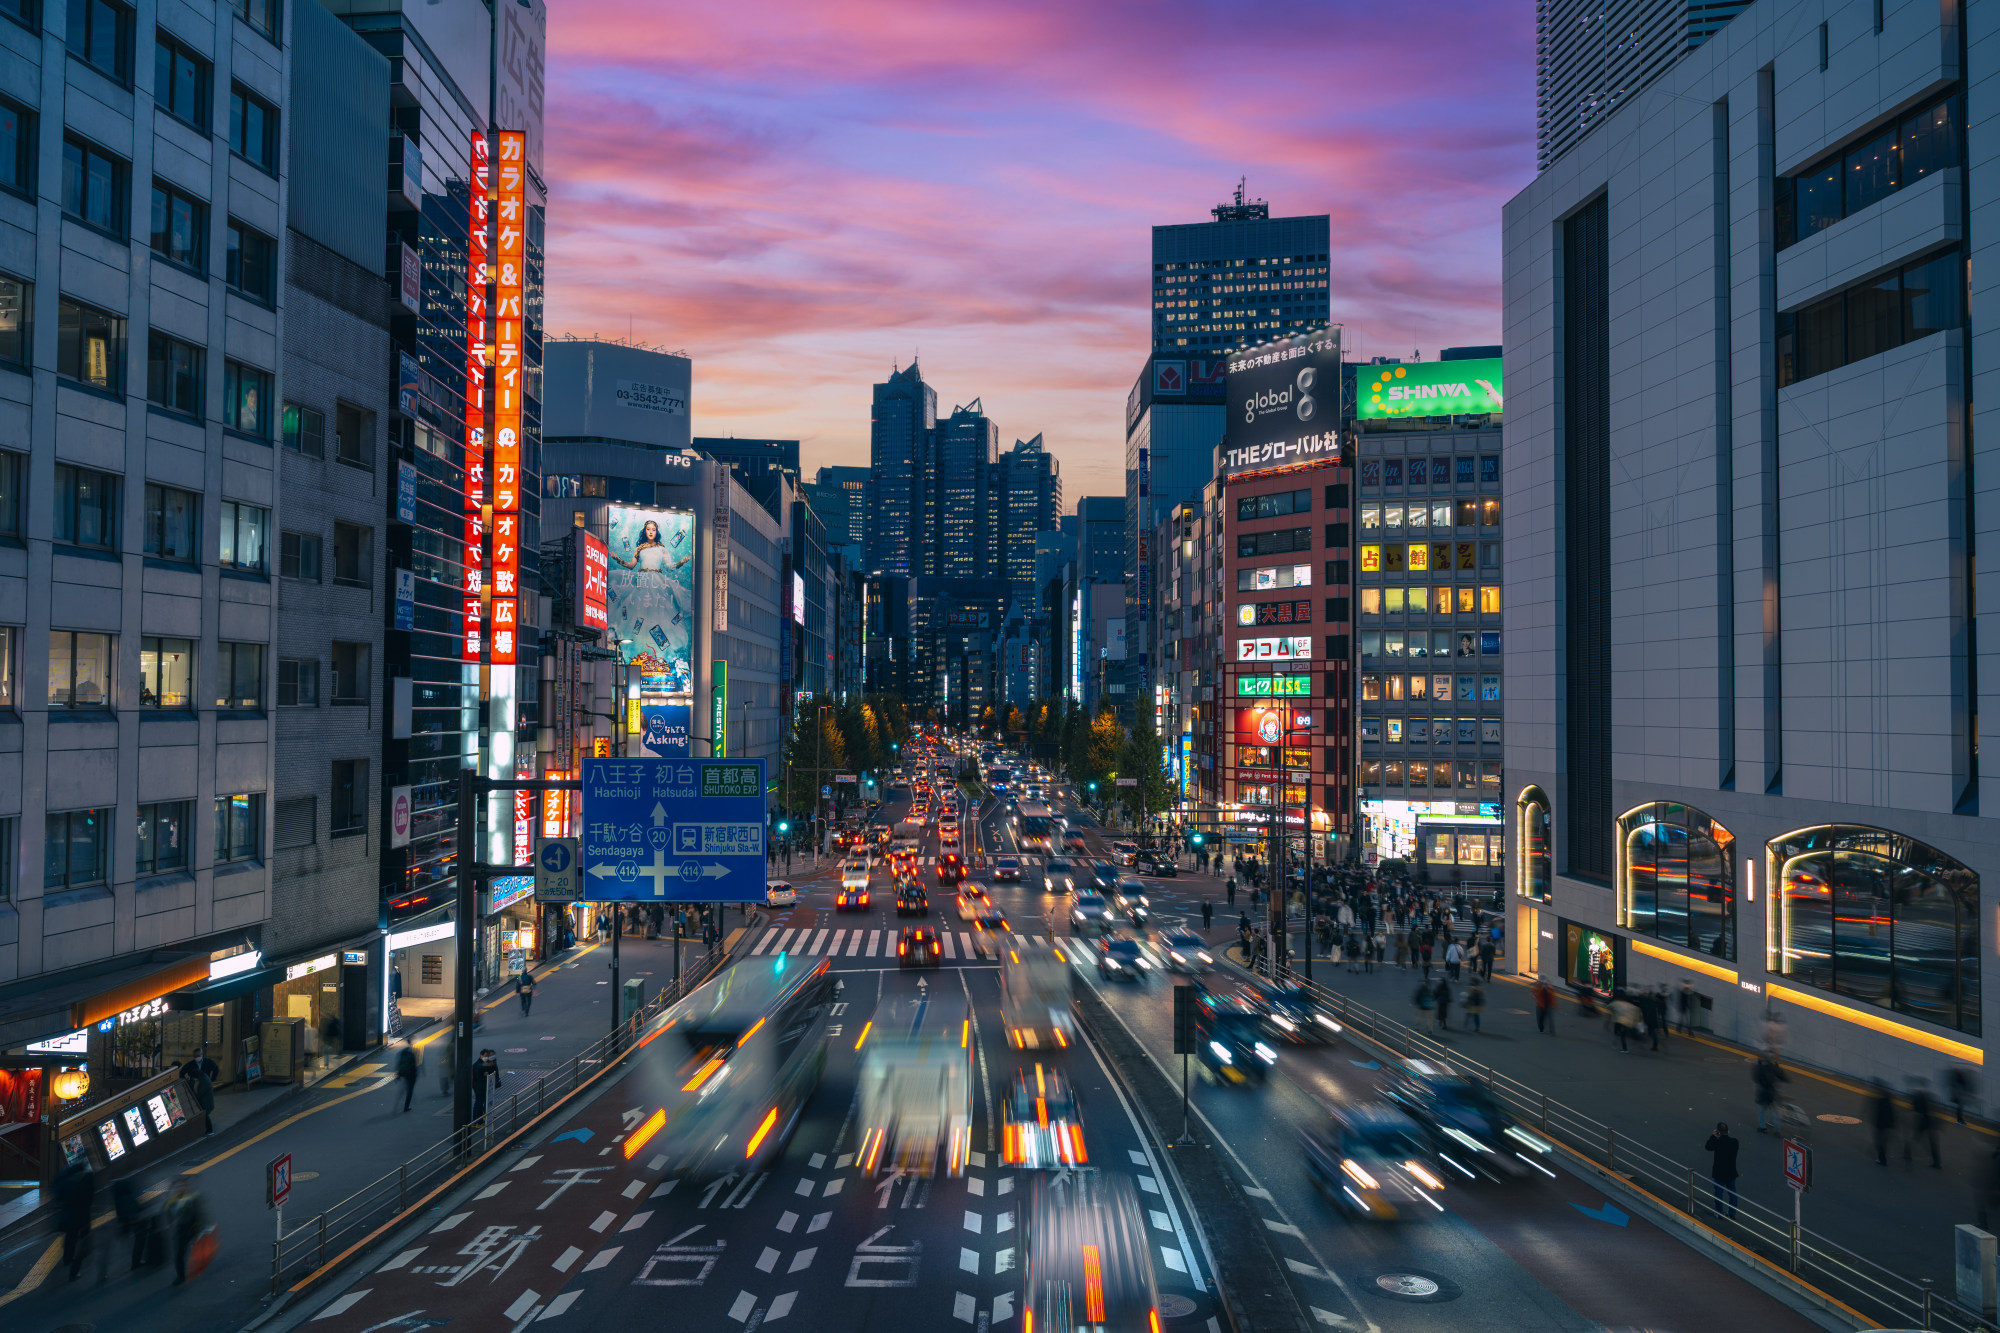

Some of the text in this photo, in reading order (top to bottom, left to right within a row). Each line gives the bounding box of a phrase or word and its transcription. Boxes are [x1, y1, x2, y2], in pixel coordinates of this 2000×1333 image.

[632, 383, 670, 396] 広告募集中
[617, 389, 684, 408] 03-3543-7771
[1246, 384, 1292, 423] global
[666, 454, 691, 467] FPG
[1262, 602, 1310, 623] 大黒屋
[1243, 641, 1289, 657] アコム
[665, 726, 685, 734] なんでも
[646, 732, 688, 747] Asking!
[589, 764, 757, 785] 八王子 初台 首都高
[594, 785, 758, 800] Hachioji Hatsudai SHUTOKO EXP
[589, 823, 760, 843] 千駄ヶ谷 20 新宿駅西口
[588, 845, 644, 858] Sendagaya
[704, 843, 736, 854] Shinjuku
[619, 867, 699, 876] 414 414
[539, 888, 574, 896] この先50m
